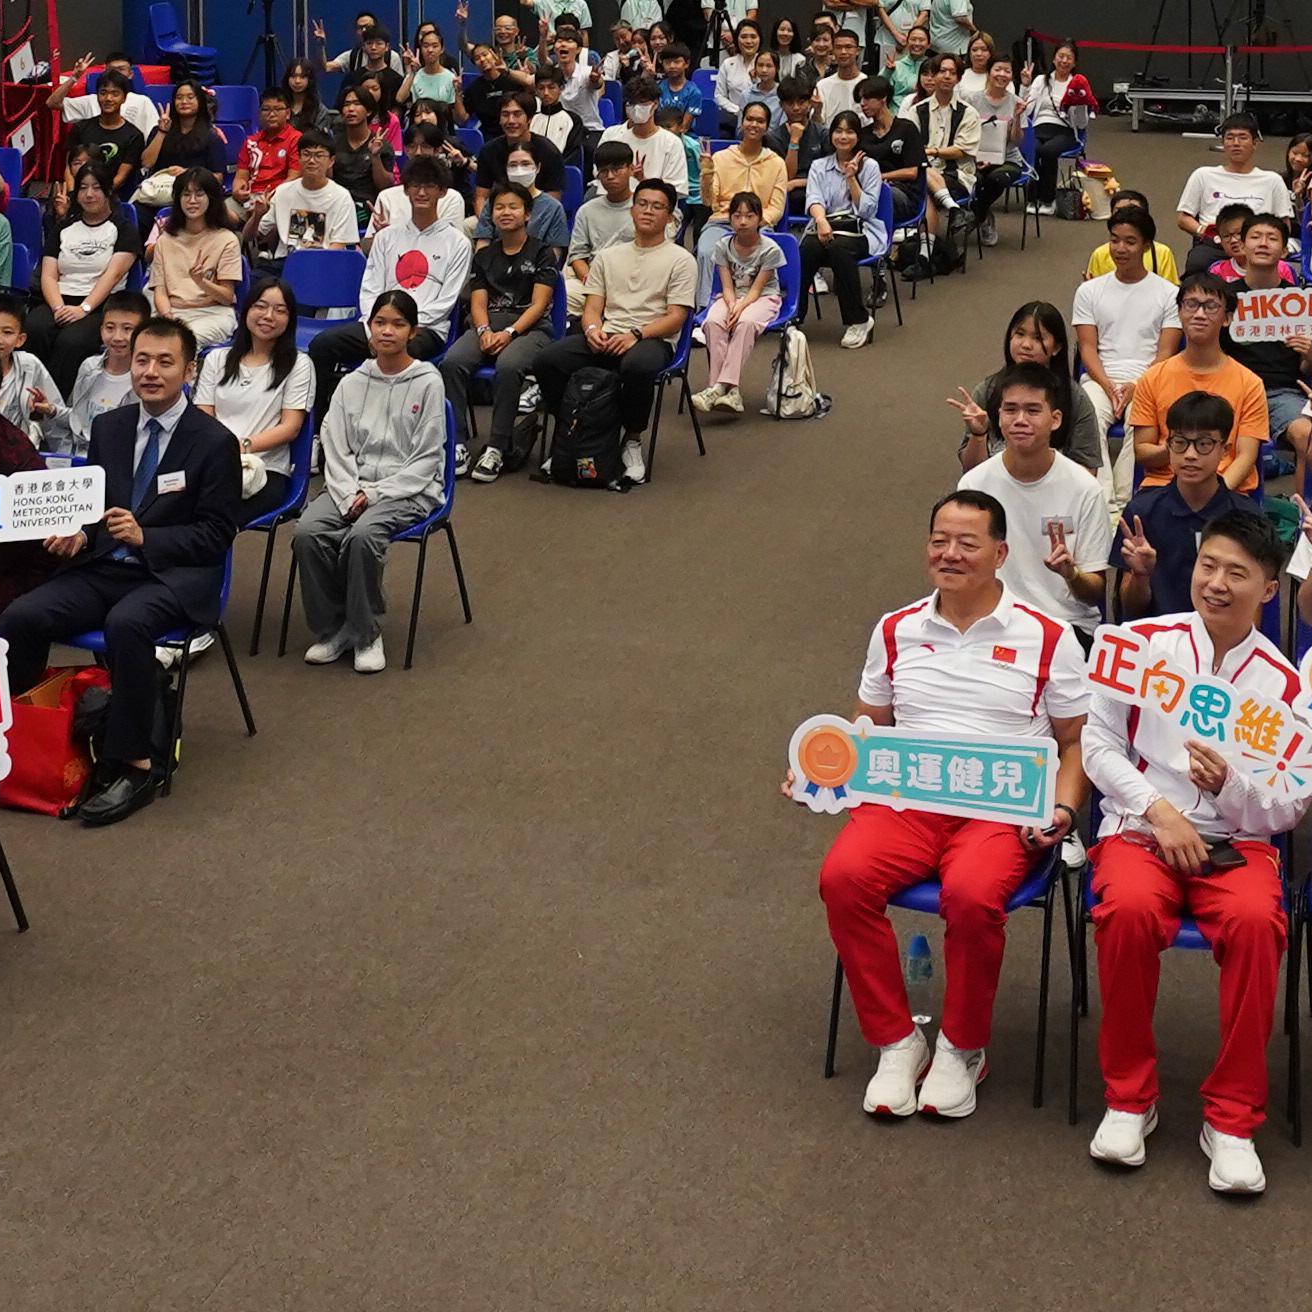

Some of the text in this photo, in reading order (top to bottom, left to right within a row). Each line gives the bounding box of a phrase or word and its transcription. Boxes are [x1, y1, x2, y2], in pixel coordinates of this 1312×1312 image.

[14, 477, 93, 495] 香港都會大學
[13, 493, 74, 507] HONG KONG
[13, 503, 93, 517] METROPOLITAN
[12, 515, 74, 528] UNIVERSITY
[866, 748, 1025, 799] 奧運健兒
